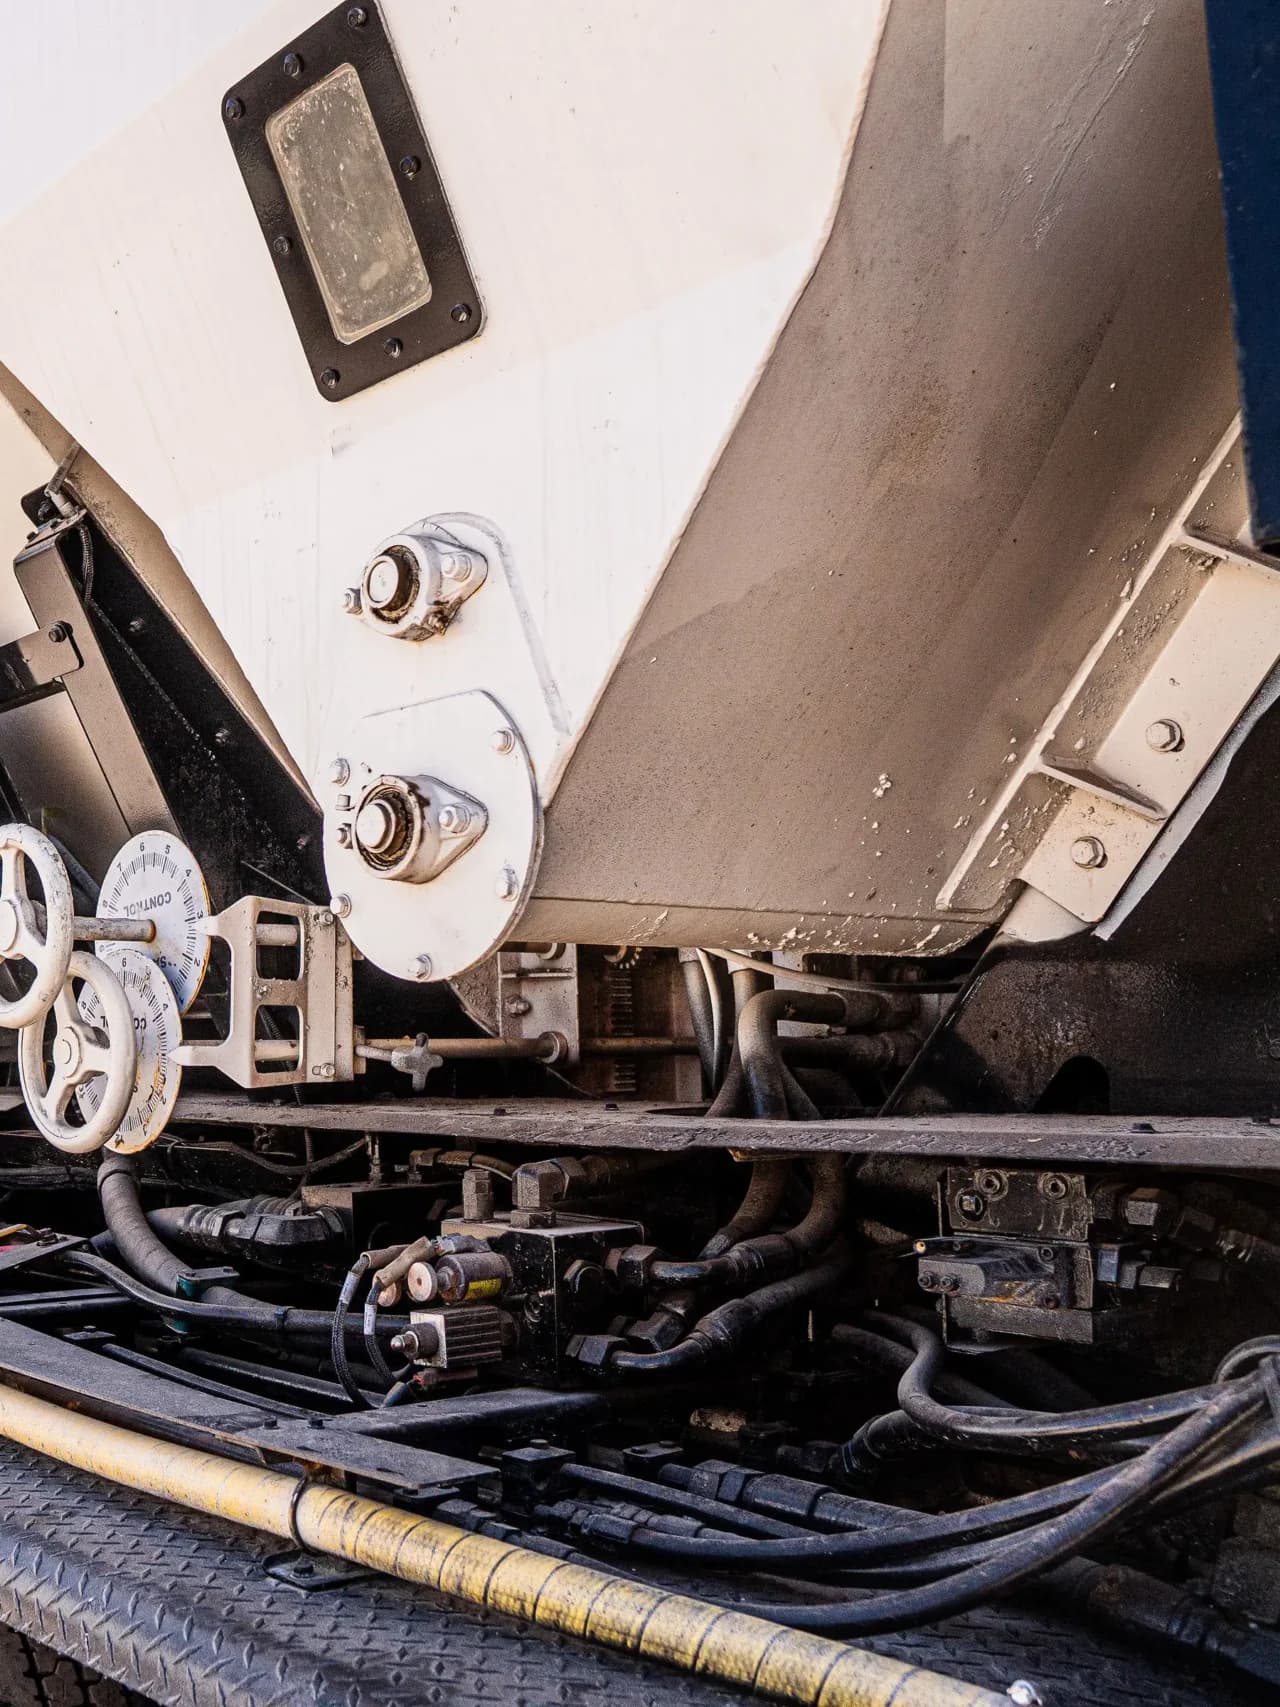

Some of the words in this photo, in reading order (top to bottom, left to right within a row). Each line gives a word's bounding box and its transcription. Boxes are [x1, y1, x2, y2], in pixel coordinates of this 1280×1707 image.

[140, 842, 145, 852] 6
[165, 844, 171, 855] 5
[117, 862, 122, 872] 7
[185, 869, 192, 877] 4
[197, 910, 204, 919] 3
[122, 957, 127, 967] 6
[194, 957, 201, 967] 2
